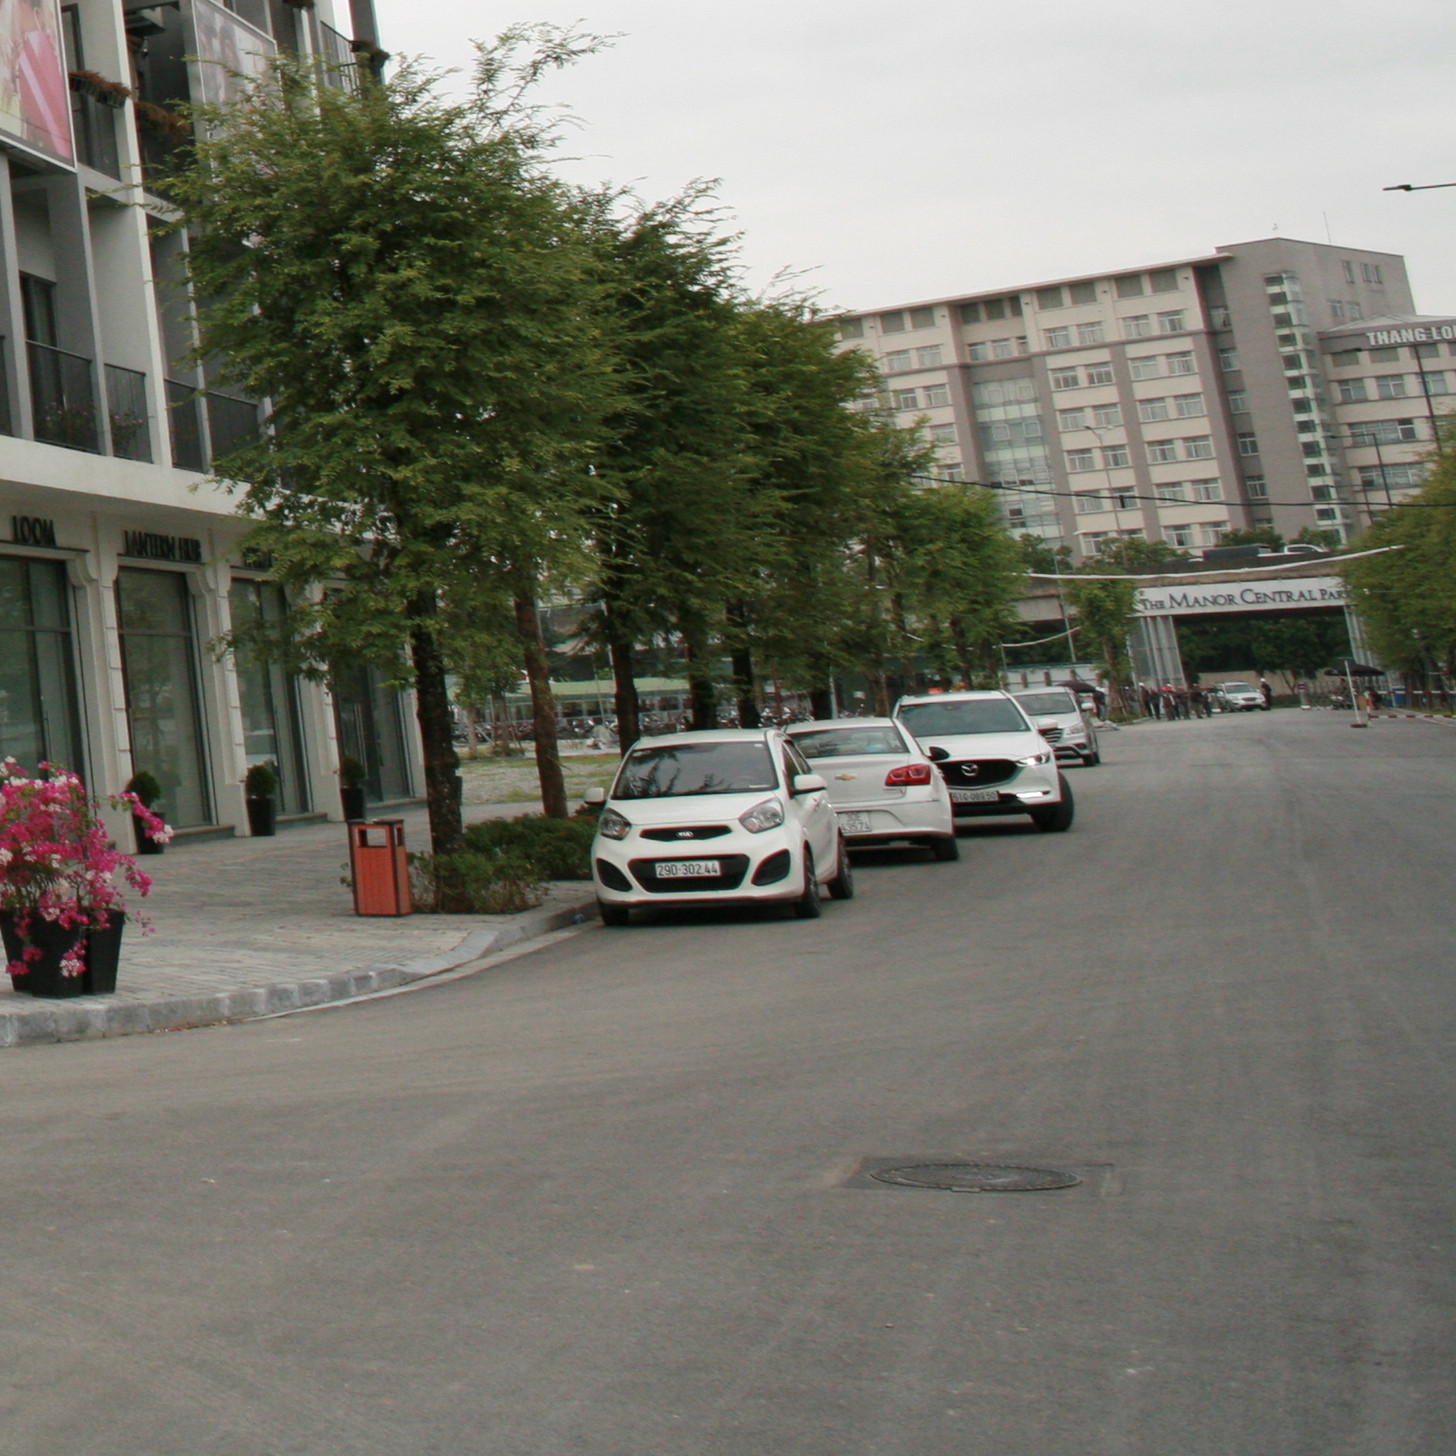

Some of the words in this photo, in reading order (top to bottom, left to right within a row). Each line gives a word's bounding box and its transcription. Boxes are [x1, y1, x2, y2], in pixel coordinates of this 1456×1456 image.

[1366, 327, 1427, 346] THANG
[1431, 323, 1456, 341] LO
[11, 515, 57, 548] LOOM
[123, 529, 177, 561] LANTERN
[1139, 597, 1166, 611] THE
[1168, 592, 1238, 610] MANOR
[1239, 587, 1319, 606] CENTRAL
[1320, 587, 1352, 601] PAR
